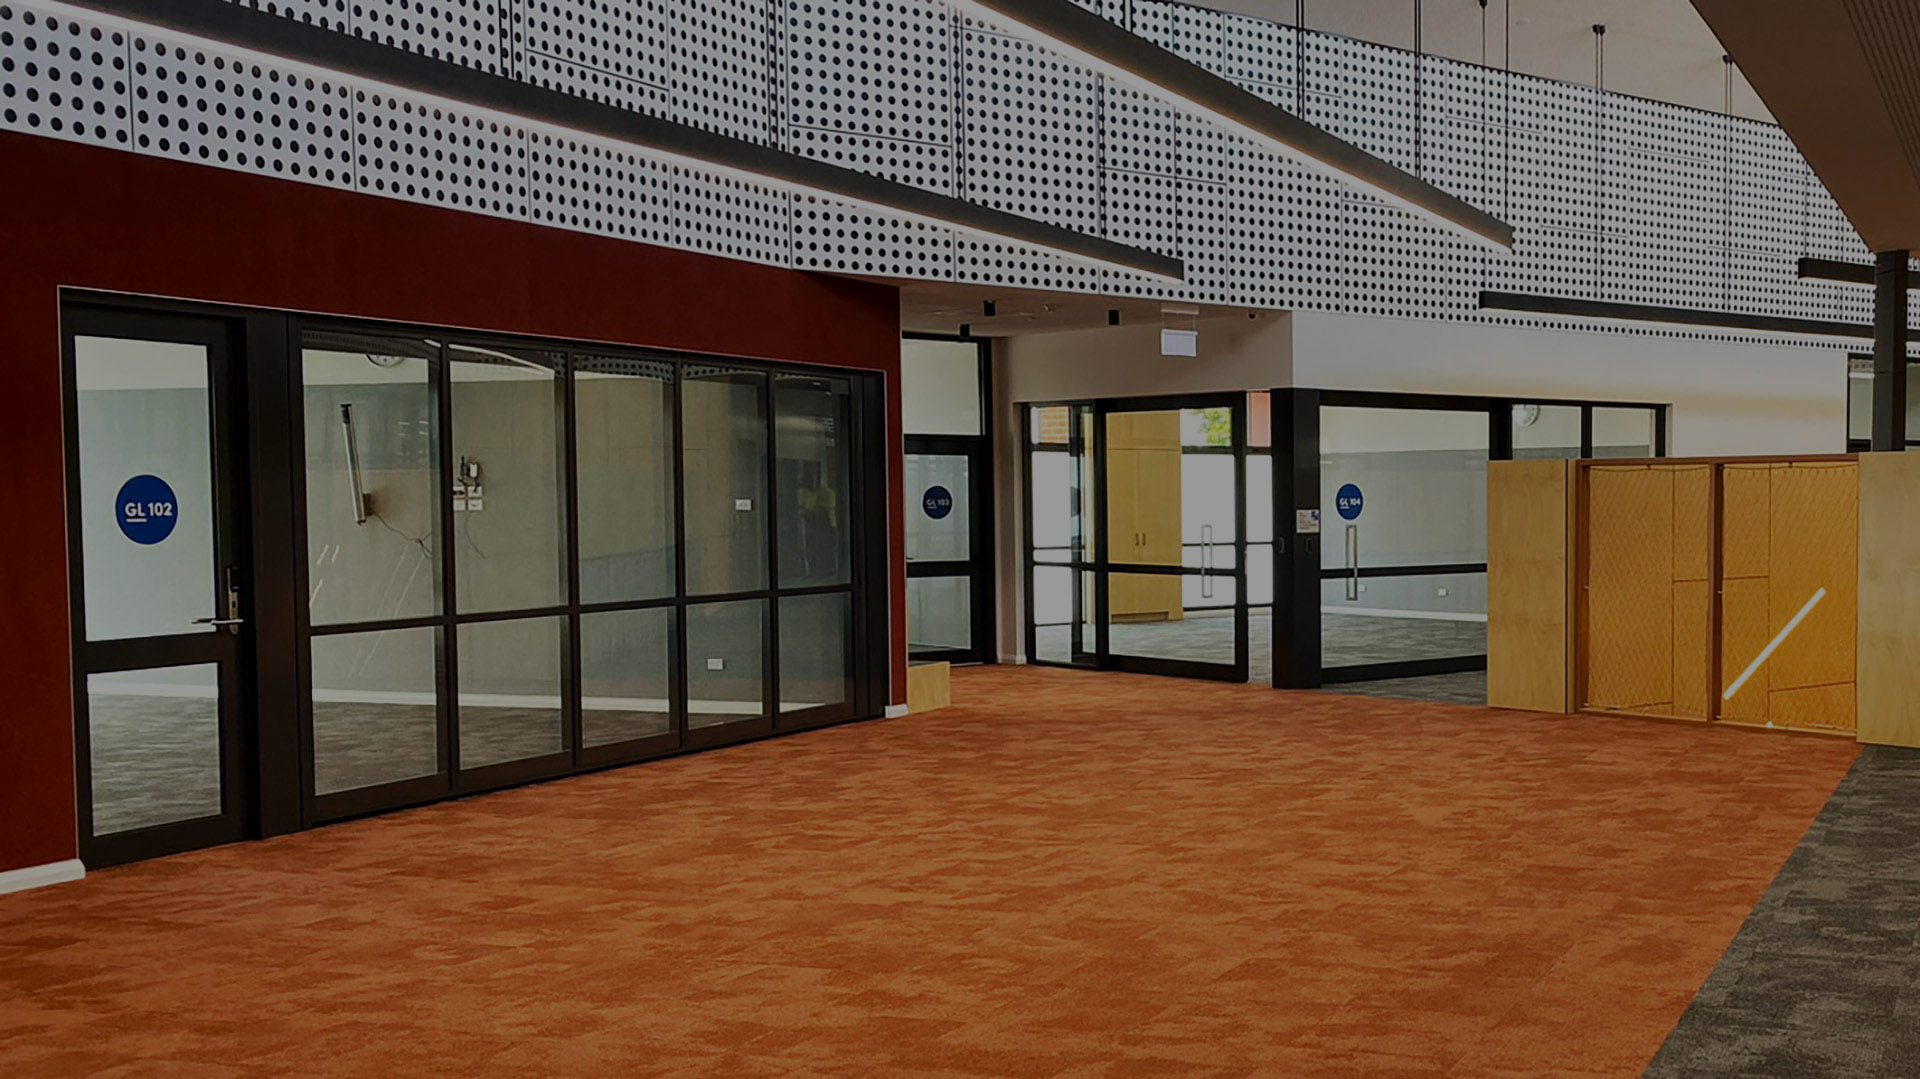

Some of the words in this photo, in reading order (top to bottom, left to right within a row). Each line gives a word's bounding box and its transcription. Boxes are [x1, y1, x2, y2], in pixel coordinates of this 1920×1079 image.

[1339, 497, 1349, 506] GL
[1349, 497, 1361, 506] 104
[124, 502, 146, 517] GL
[147, 502, 173, 517] 102
